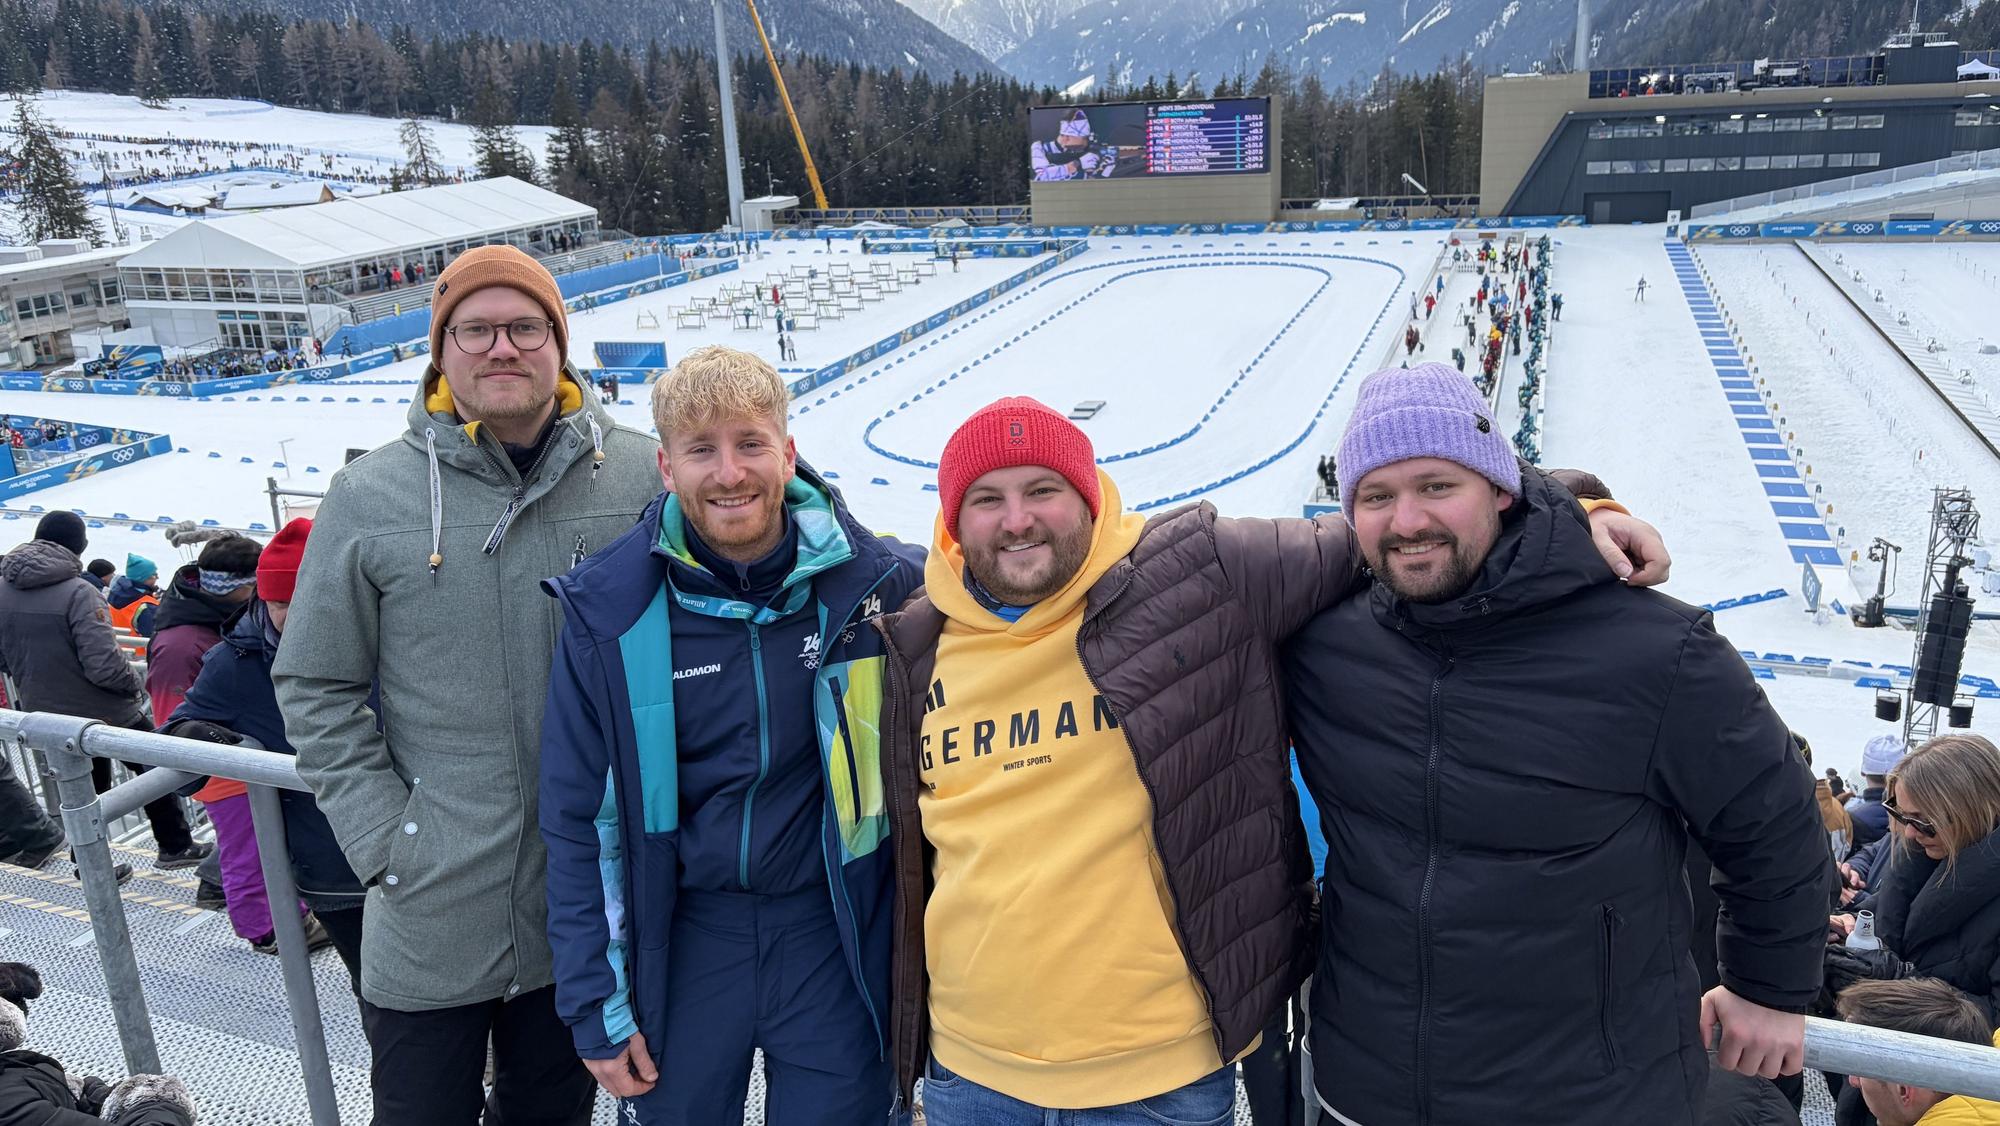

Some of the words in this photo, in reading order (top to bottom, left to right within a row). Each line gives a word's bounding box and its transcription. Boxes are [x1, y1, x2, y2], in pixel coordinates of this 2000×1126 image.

[682, 598, 706, 609] Allianz
[673, 664, 720, 680] ALOMON
[1002, 760, 1024, 772] WINTER
[1026, 755, 1052, 766] SPORTS
